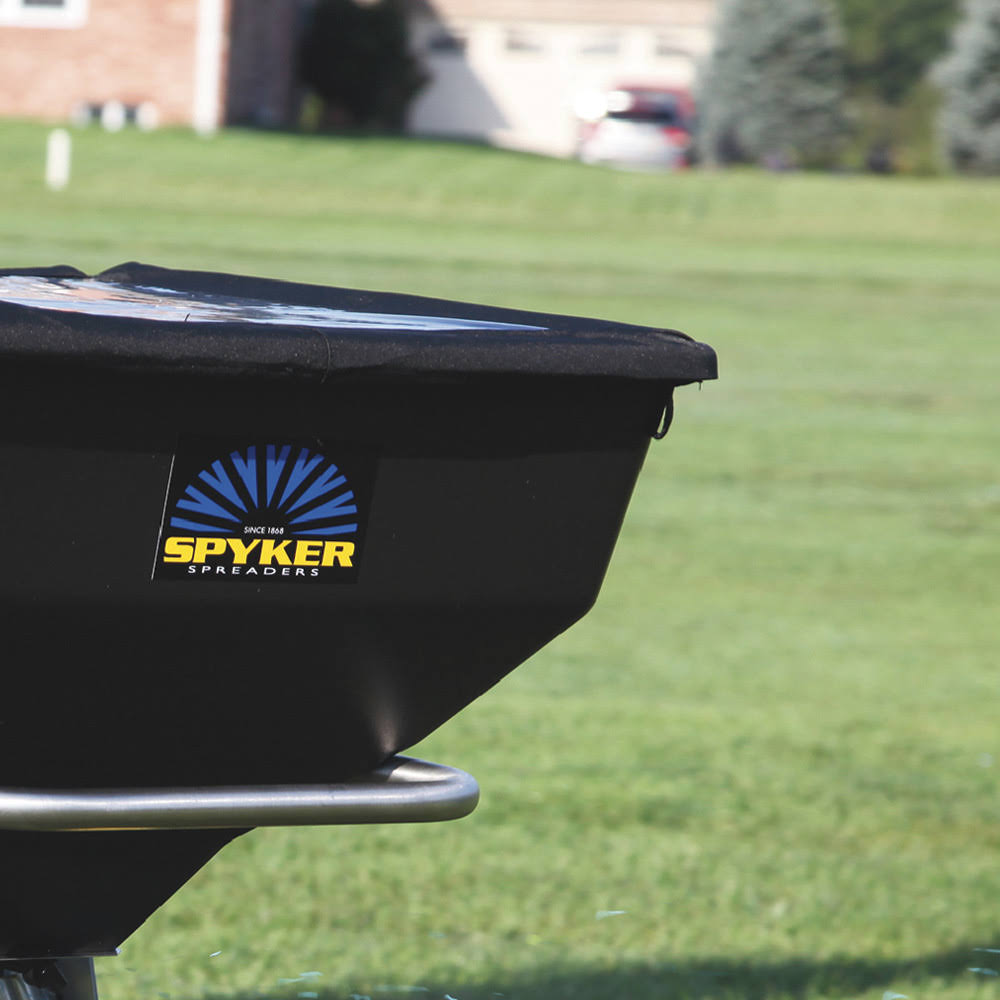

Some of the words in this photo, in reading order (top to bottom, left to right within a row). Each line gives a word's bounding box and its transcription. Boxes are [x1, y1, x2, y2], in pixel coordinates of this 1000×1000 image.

[244, 526, 266, 535] SINCE
[267, 526, 284, 535] 1868
[164, 536, 355, 567] SPYKER
[188, 565, 319, 576] SPREADERS
